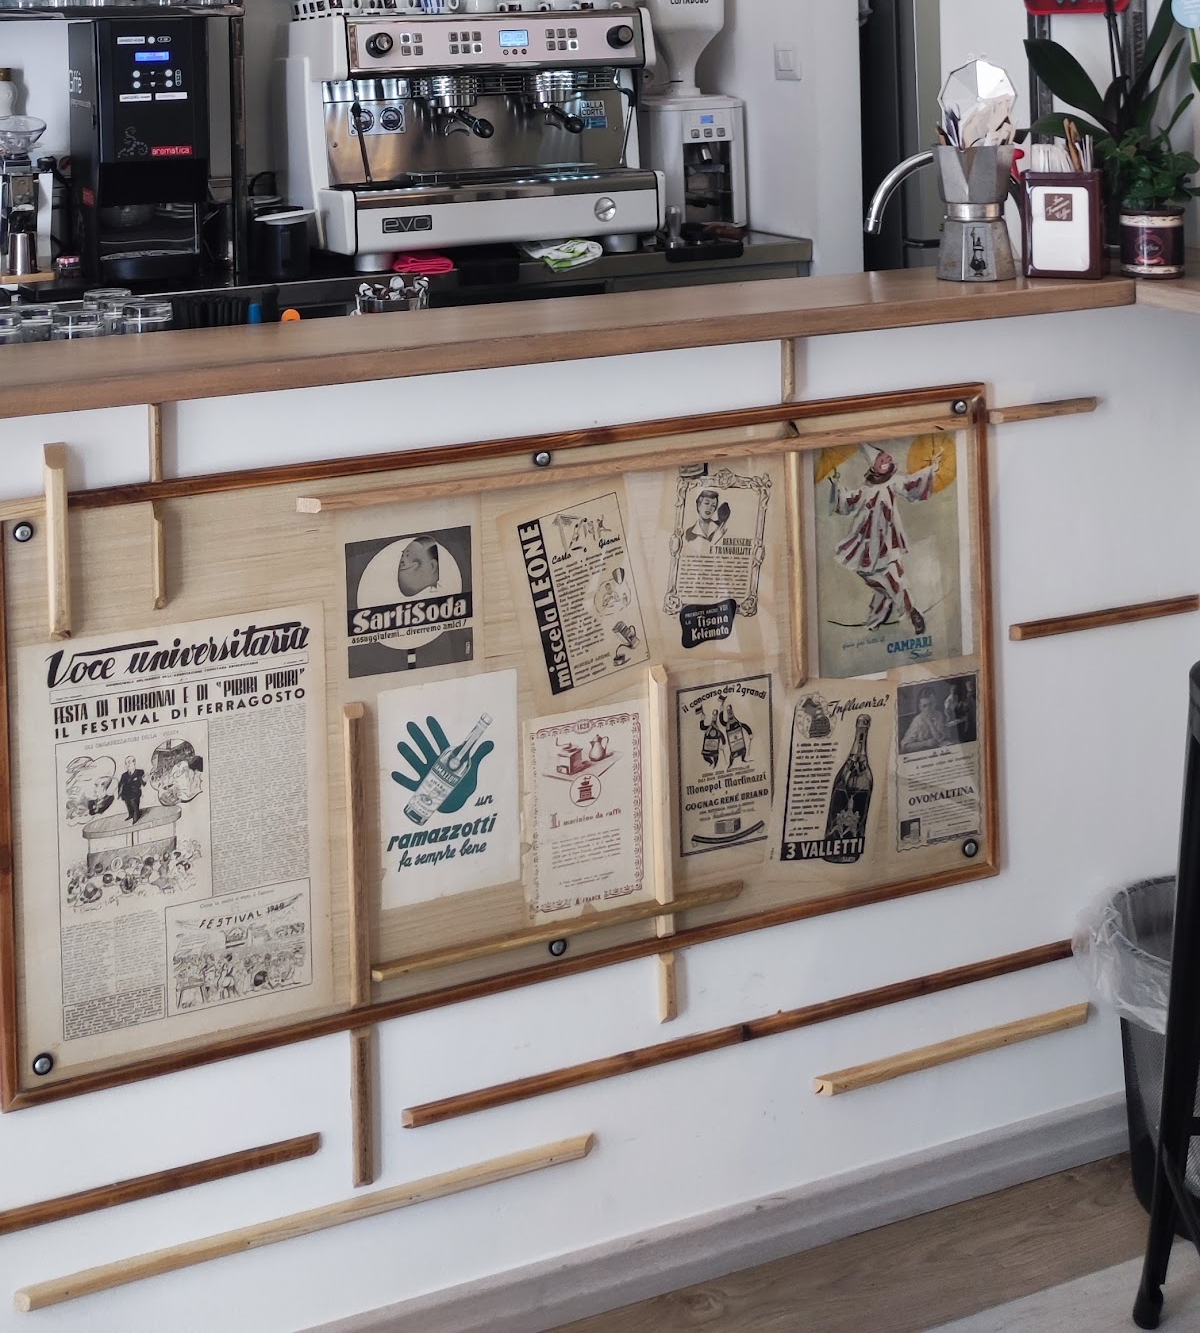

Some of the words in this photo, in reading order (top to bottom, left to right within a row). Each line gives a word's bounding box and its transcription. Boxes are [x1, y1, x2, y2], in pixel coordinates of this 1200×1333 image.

[151, 145, 190, 156] aromatica
[519, 523, 557, 608] LEONE
[353, 596, 467, 634] SartiSoda
[697, 614, 729, 627] Tisana
[45, 639, 159, 688] Voce
[125, 621, 310, 675] universitaria
[541, 608, 573, 688] miscela
[887, 636, 933, 654] CAMPARI
[54, 702, 89, 725] FESTA
[96, 698, 109, 718] DI
[117, 688, 176, 714] TORRONAI
[184, 686, 189, 704] E
[196, 683, 208, 702] DI
[55, 727, 69, 739] IL
[81, 712, 160, 735] FESTIVAL
[171, 707, 188, 719] DI
[197, 687, 306, 716] FERRAGOSTO
[682, 705, 689, 714] il
[689, 689, 722, 710] concorso
[722, 684, 736, 694] dei
[736, 683, 741, 693] 2
[741, 686, 768, 700] grandi
[474, 793, 494, 808] un
[686, 779, 722, 795] Monopol
[908, 785, 975, 807] OVOMALTINA
[387, 812, 498, 853] ramazzotti
[398, 849, 413, 873] fa
[414, 844, 457, 867] sempre
[459, 837, 488, 856] bene
[786, 843, 796, 860] 3
[800, 837, 863, 859] VALLETTI
[199, 909, 263, 930] FESTIVAL
